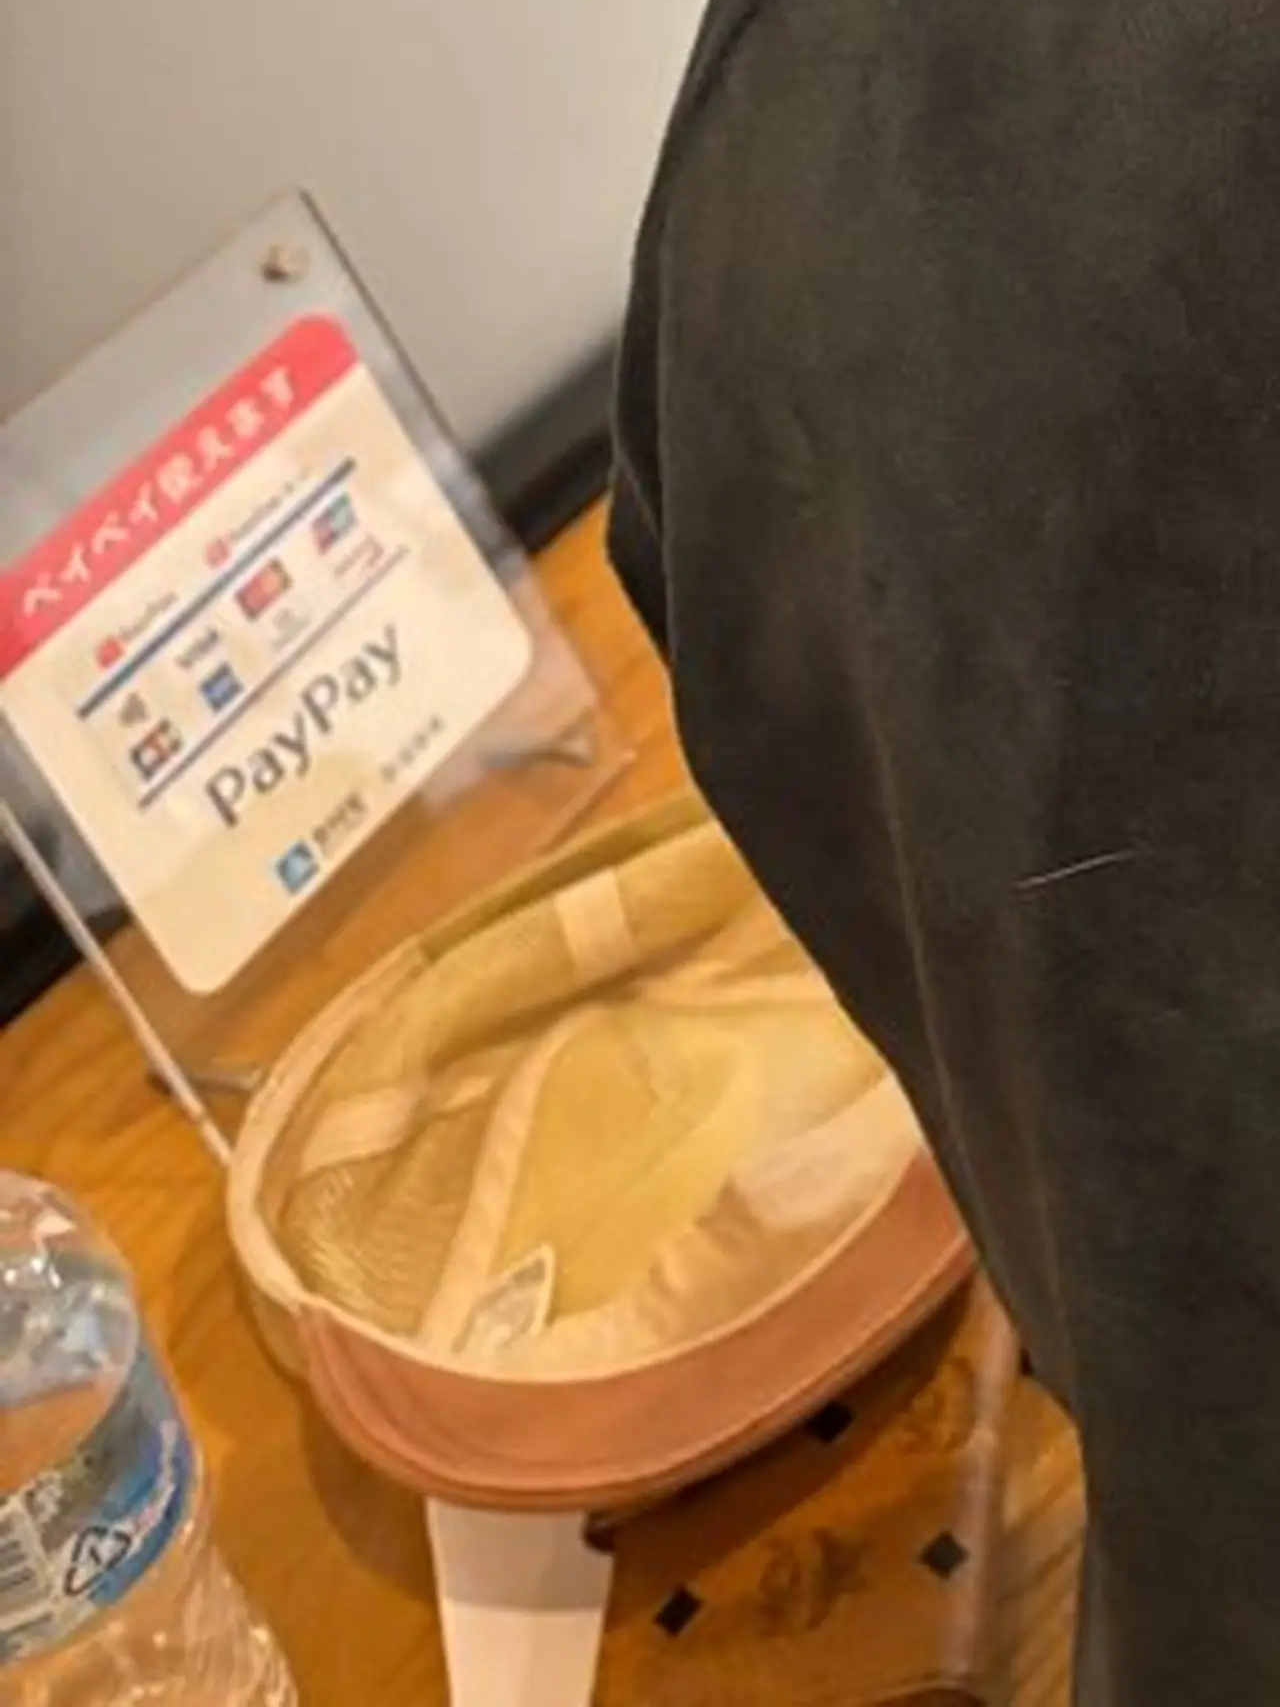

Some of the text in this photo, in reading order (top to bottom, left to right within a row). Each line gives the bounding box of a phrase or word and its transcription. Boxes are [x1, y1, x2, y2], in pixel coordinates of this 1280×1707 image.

[21, 366, 295, 618] ペイペイ使えます
[204, 623, 401, 829] PayPay
